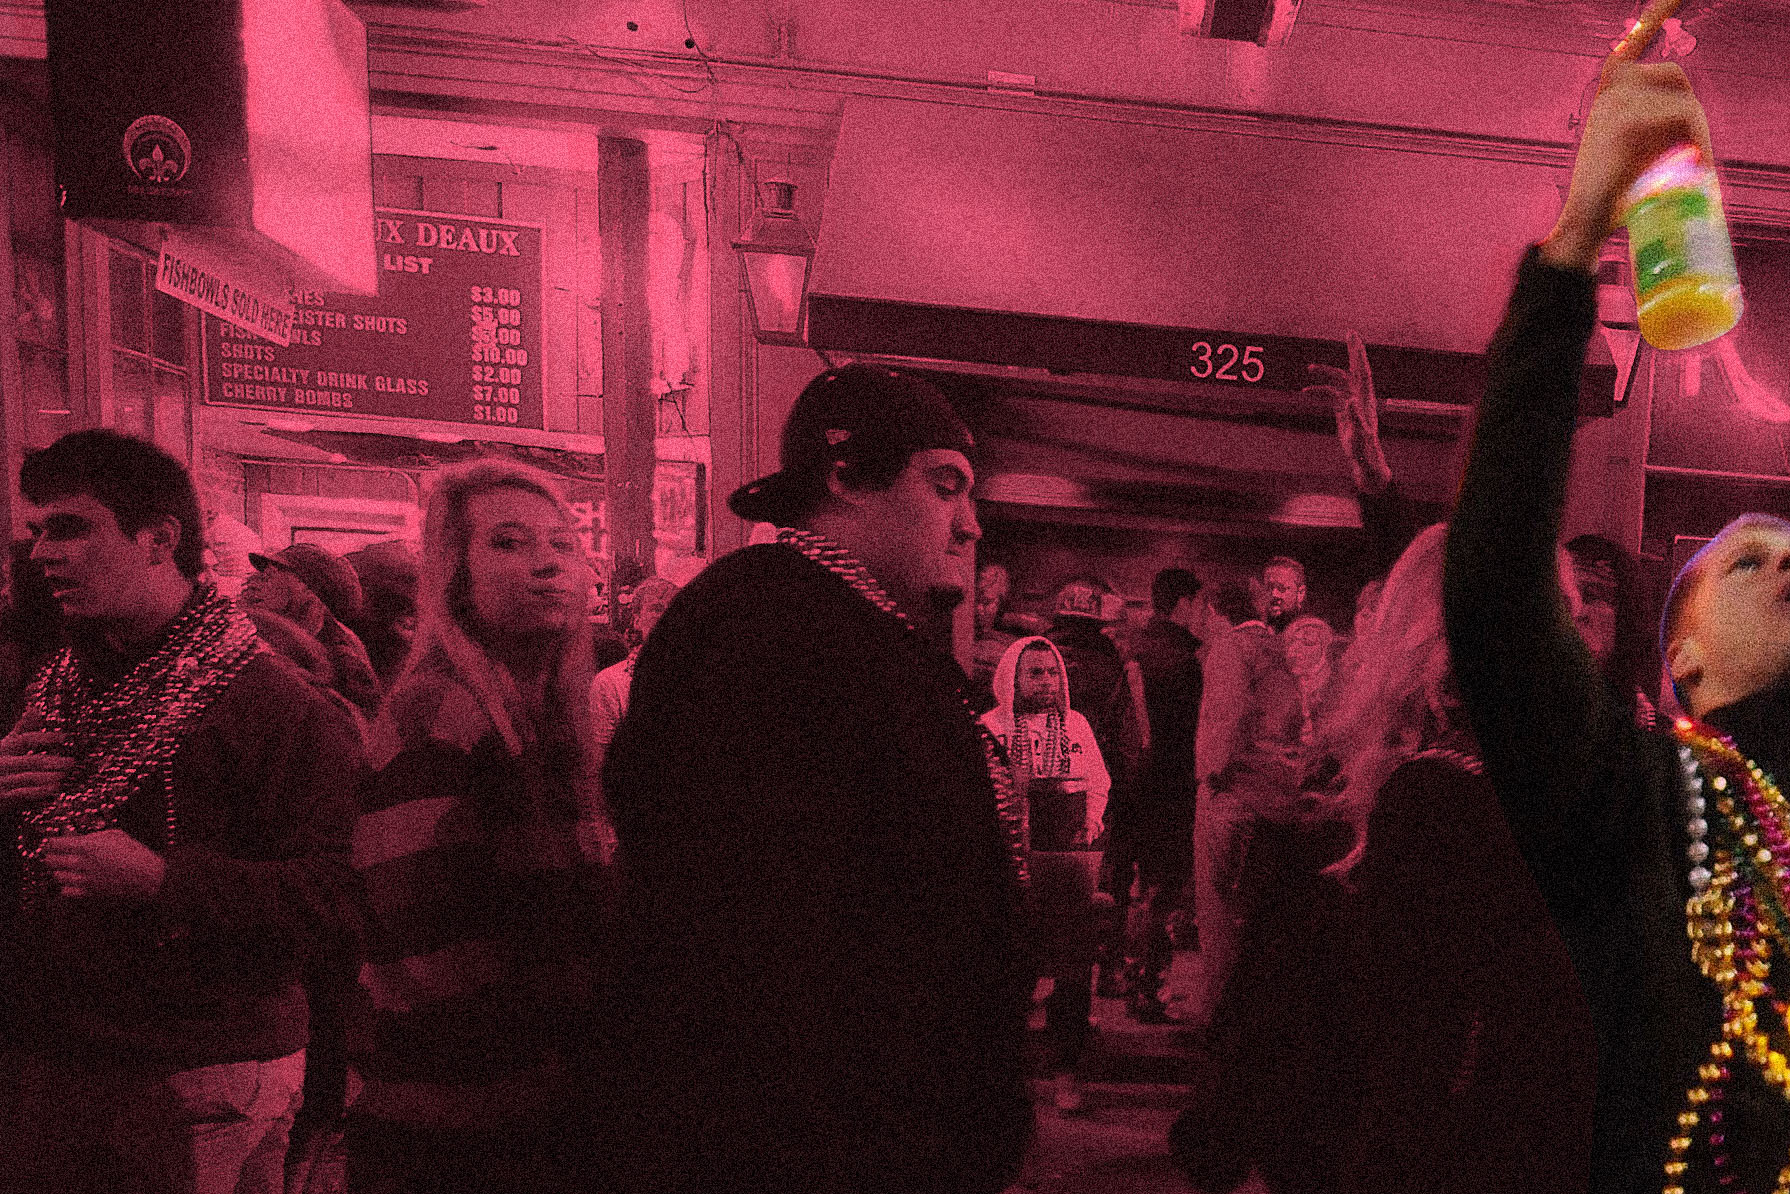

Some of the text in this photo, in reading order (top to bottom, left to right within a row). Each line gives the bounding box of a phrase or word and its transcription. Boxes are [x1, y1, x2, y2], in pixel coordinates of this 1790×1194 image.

[416, 222, 520, 256] DEAUX
[383, 253, 433, 274] LIST
[162, 252, 230, 310] FISHBOWLS
[230, 287, 260, 323] SOLD
[260, 303, 291, 338] HERE
[471, 286, 521, 307] $3.00
[353, 314, 408, 335] SHOTS
[471, 305, 521, 326] $5.00
[220, 342, 275, 362] SHOTS
[472, 342, 528, 367] $10.00
[1190, 341, 1265, 383] 325
[221, 362, 430, 397] SPECIALTY DRINK GLASS
[472, 365, 522, 385] $2.00
[222, 382, 353, 409] CHERRY BOMBS
[473, 384, 520, 405] $7.00
[474, 404, 518, 424] $1.00
